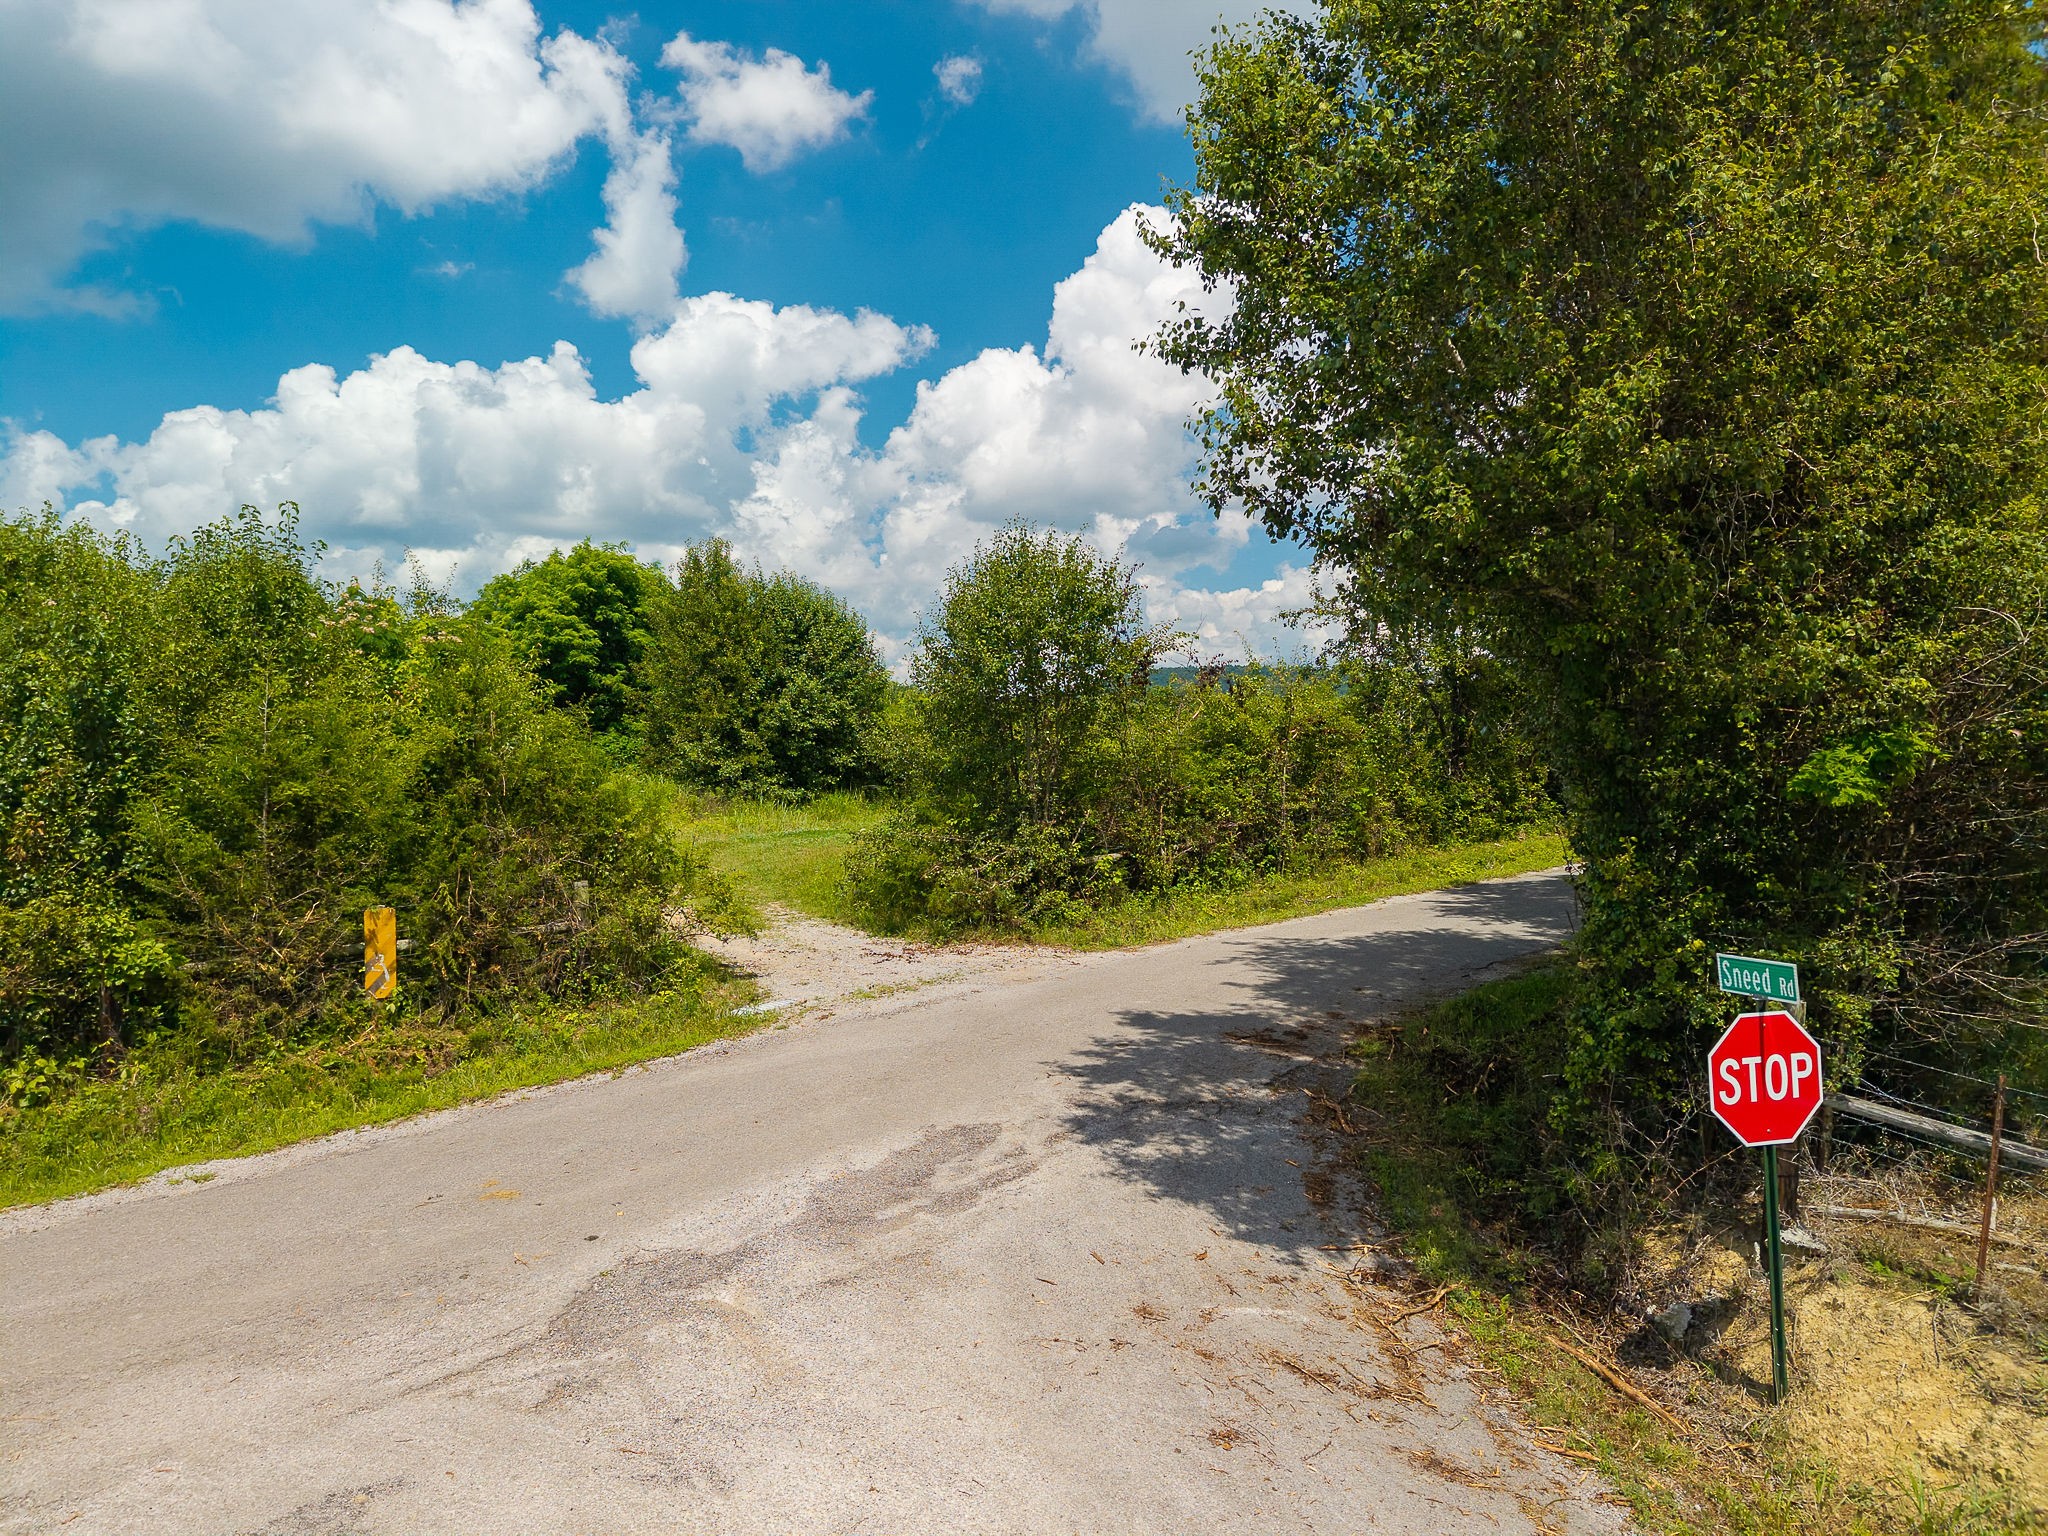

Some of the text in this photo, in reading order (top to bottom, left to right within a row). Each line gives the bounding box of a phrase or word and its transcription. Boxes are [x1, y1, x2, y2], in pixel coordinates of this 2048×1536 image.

[1722, 960, 1794, 997] Sneed Rd
[1719, 1052, 1813, 1105] STOP
